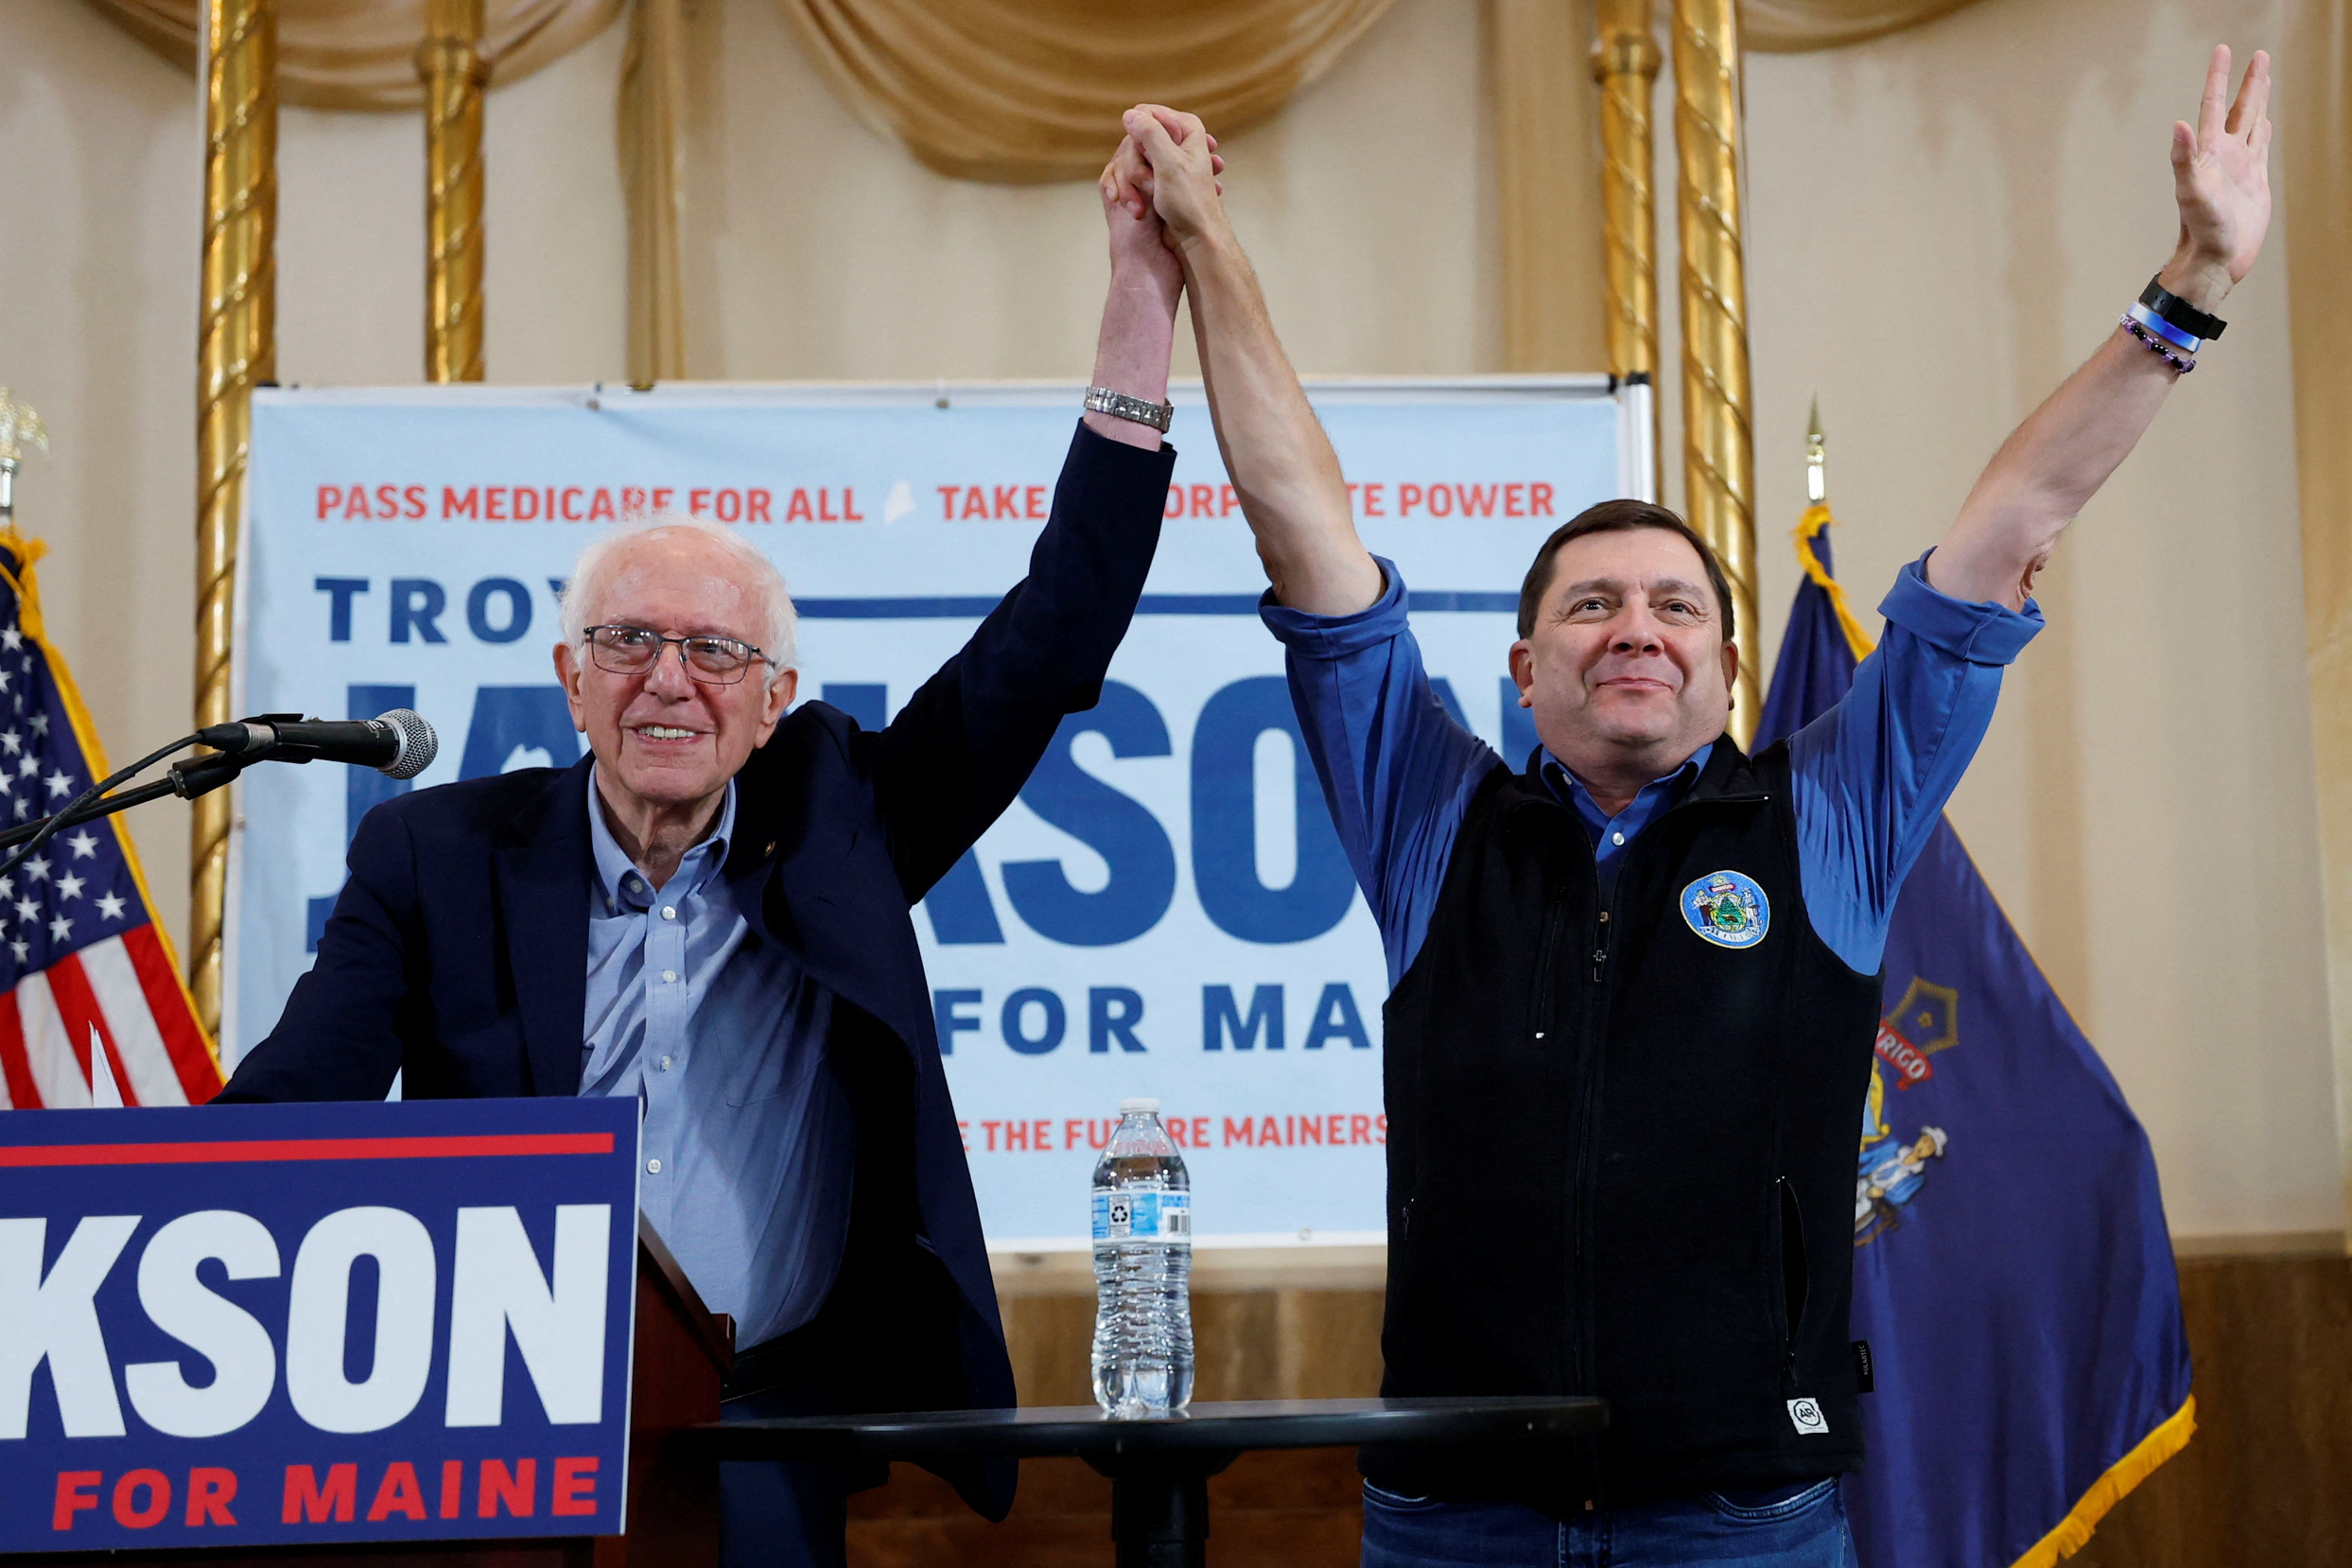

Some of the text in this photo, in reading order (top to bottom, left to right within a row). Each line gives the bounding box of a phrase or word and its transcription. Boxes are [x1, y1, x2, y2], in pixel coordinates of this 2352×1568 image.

[317, 484, 864, 522] PASS MEDICARE FOR ALL
[937, 486, 1047, 520] TAKE
[1399, 482, 1554, 518] POWER
[933, 986, 1146, 1056] FOR
[981, 1120, 1053, 1151] THE
[1065, 1117, 1211, 1151] FURE
[53, 1457, 599, 1530] FOR MAINE
